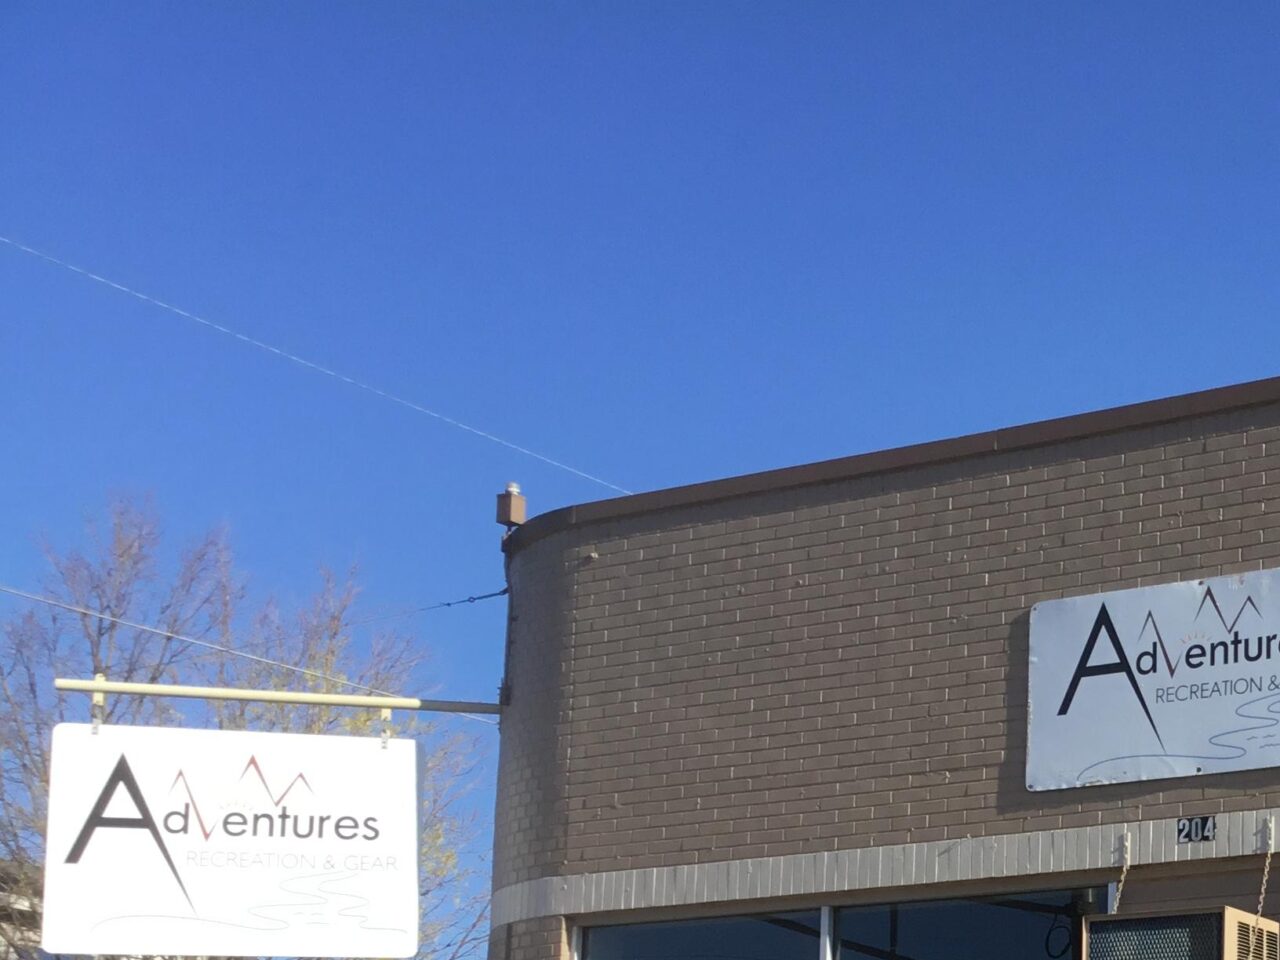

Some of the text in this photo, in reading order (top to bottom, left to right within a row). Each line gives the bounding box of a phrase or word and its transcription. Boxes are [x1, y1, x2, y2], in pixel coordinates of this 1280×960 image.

[1155, 675, 1263, 703] RECREATION
[1267, 674, 1280, 691] &
[1178, 816, 1216, 843] 204
[186, 850, 399, 871] RECREATION & GEAR
